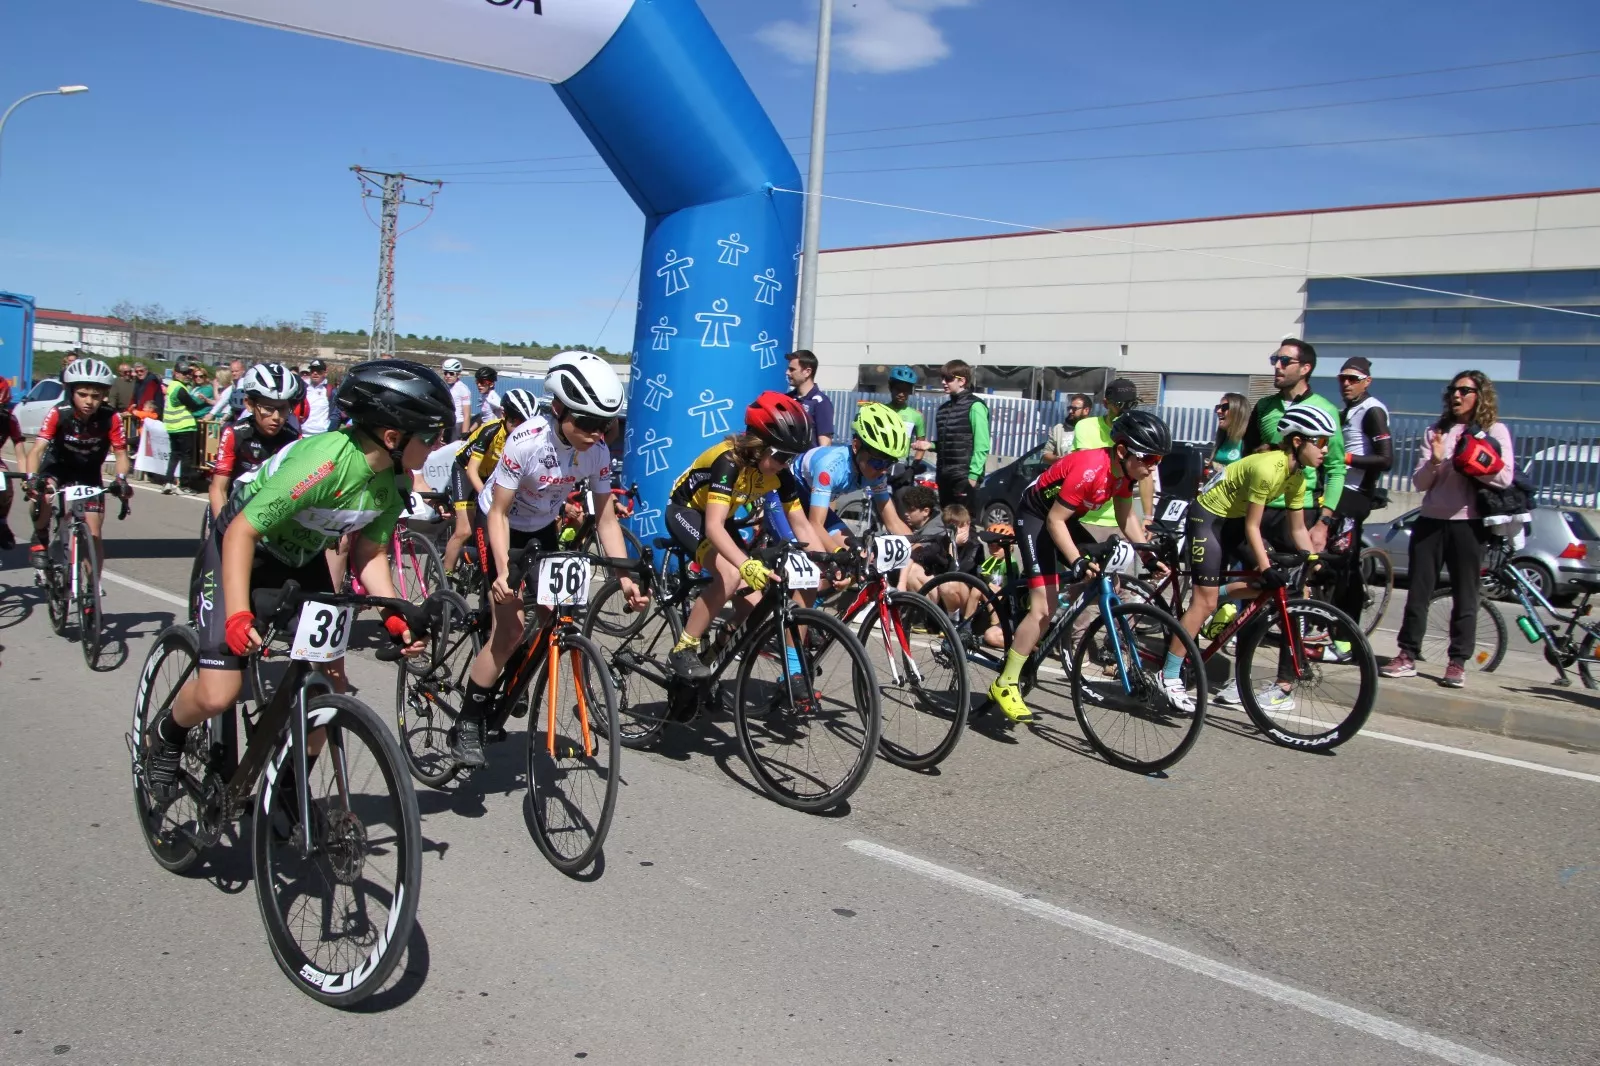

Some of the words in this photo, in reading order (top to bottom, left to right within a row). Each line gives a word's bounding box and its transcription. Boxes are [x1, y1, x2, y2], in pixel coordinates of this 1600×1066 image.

[73, 487, 94, 497] 46
[1168, 501, 1181, 516] 84
[675, 512, 700, 541] ENTERCOD
[884, 538, 904, 562] 98
[1112, 544, 1129, 566] 37
[548, 562, 581, 594] 56
[790, 555, 814, 578] 44
[309, 609, 347, 648] 38
[1268, 728, 1339, 746] ROTHAR
